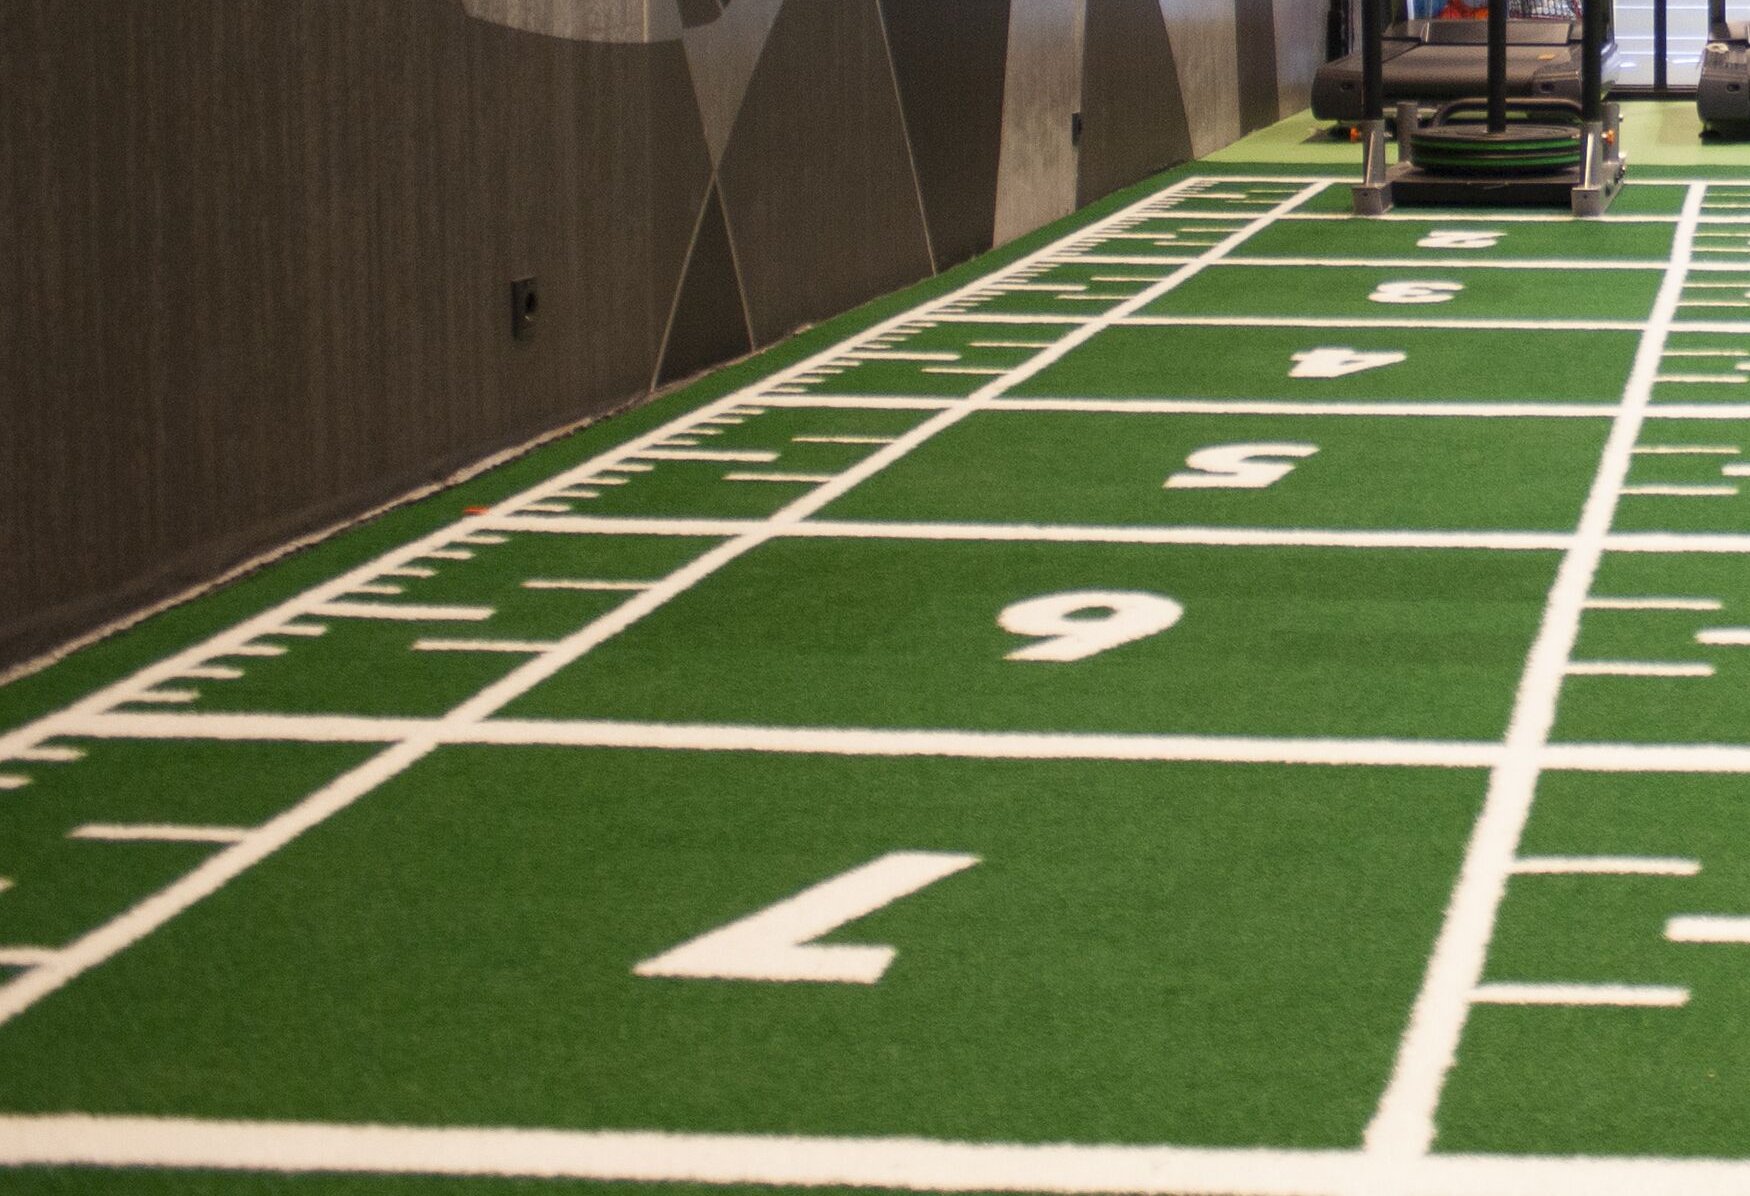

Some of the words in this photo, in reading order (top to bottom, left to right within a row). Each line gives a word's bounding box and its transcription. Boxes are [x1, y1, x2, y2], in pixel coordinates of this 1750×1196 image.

[1417, 229, 1508, 249] 2
[1368, 279, 1465, 304] 3
[1288, 346, 1408, 378] 4
[1163, 442, 1320, 489] 5
[998, 590, 1184, 662] 6
[633, 851, 982, 984] 7
